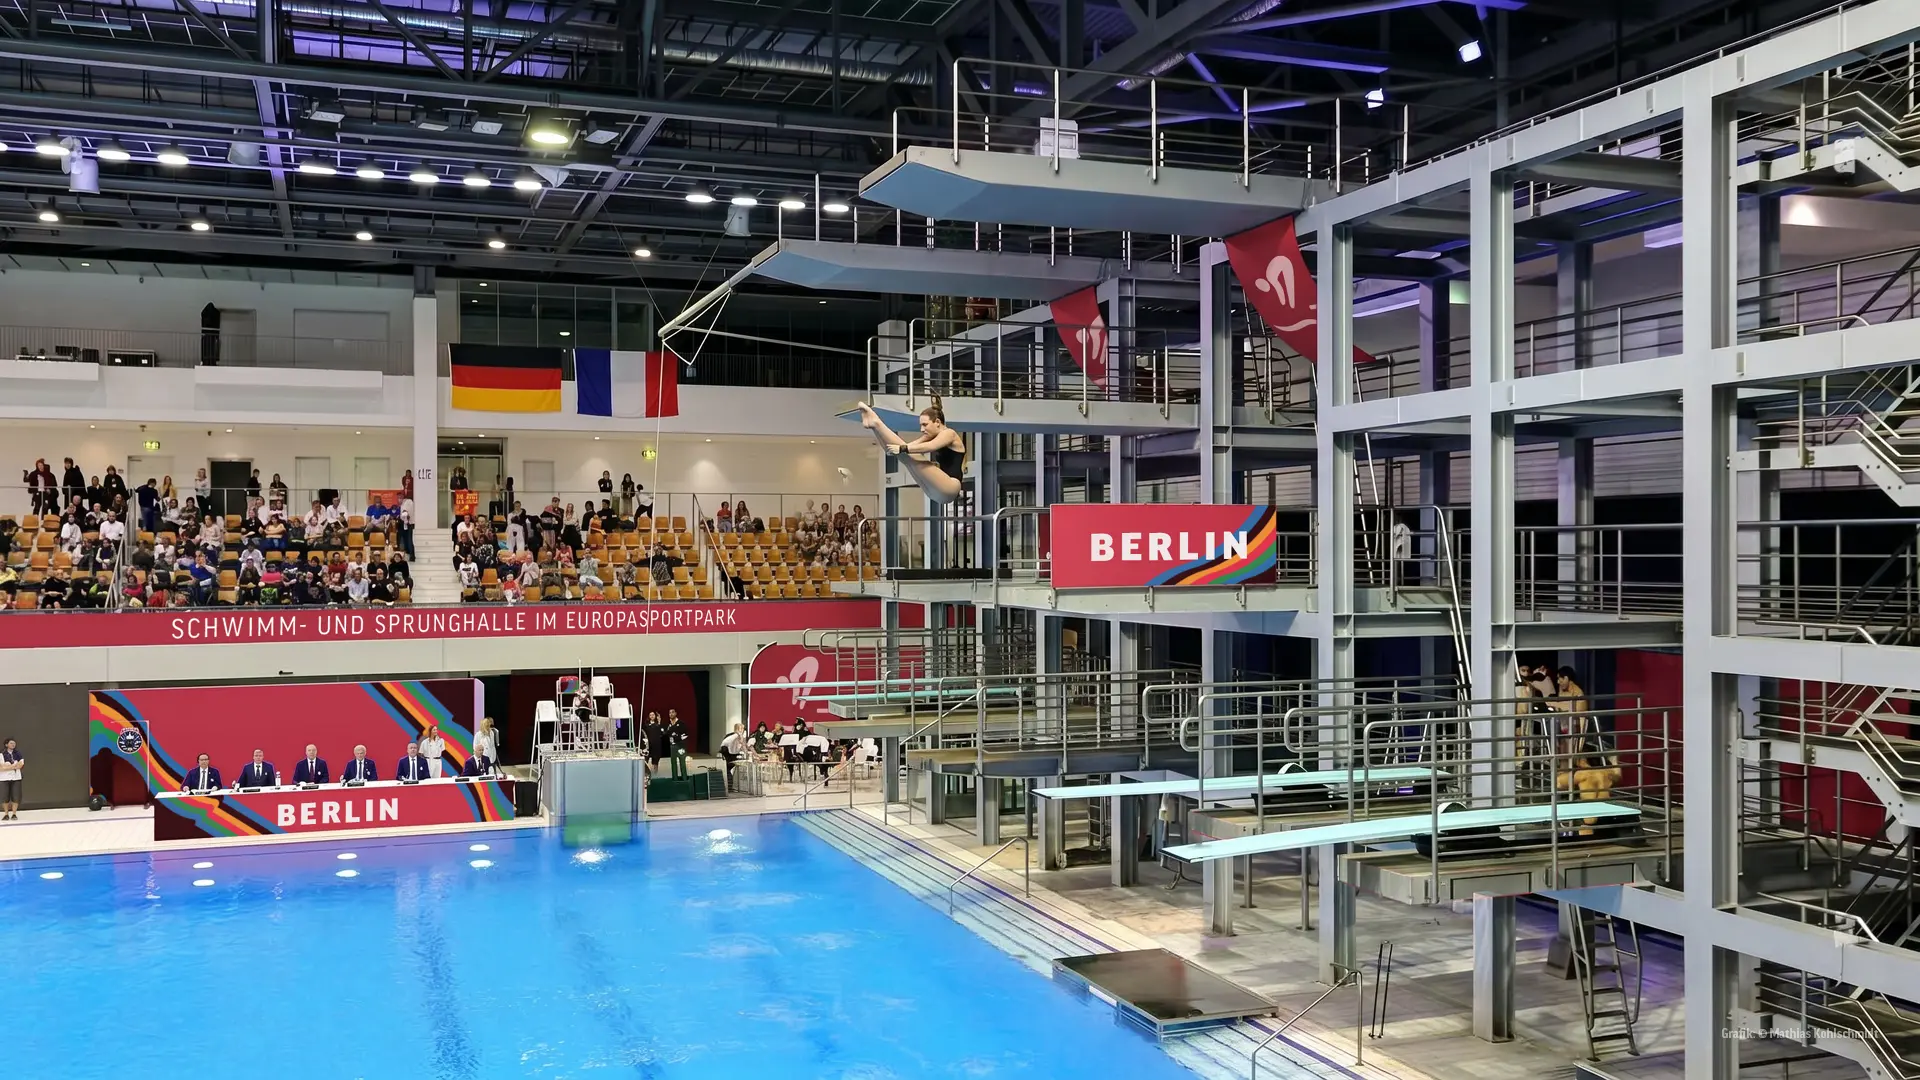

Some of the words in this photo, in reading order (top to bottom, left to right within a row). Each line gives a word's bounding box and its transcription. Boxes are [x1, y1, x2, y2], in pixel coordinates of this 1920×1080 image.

[1090, 531, 1248, 562] BERLIN
[171, 615, 307, 640] SCHWIMM-
[317, 614, 365, 636] UND
[374, 613, 525, 634] SPRUNGHALLE
[535, 612, 557, 630] IM
[565, 608, 737, 630] EUROPASPORTPARK
[277, 797, 399, 827] BERLIN
